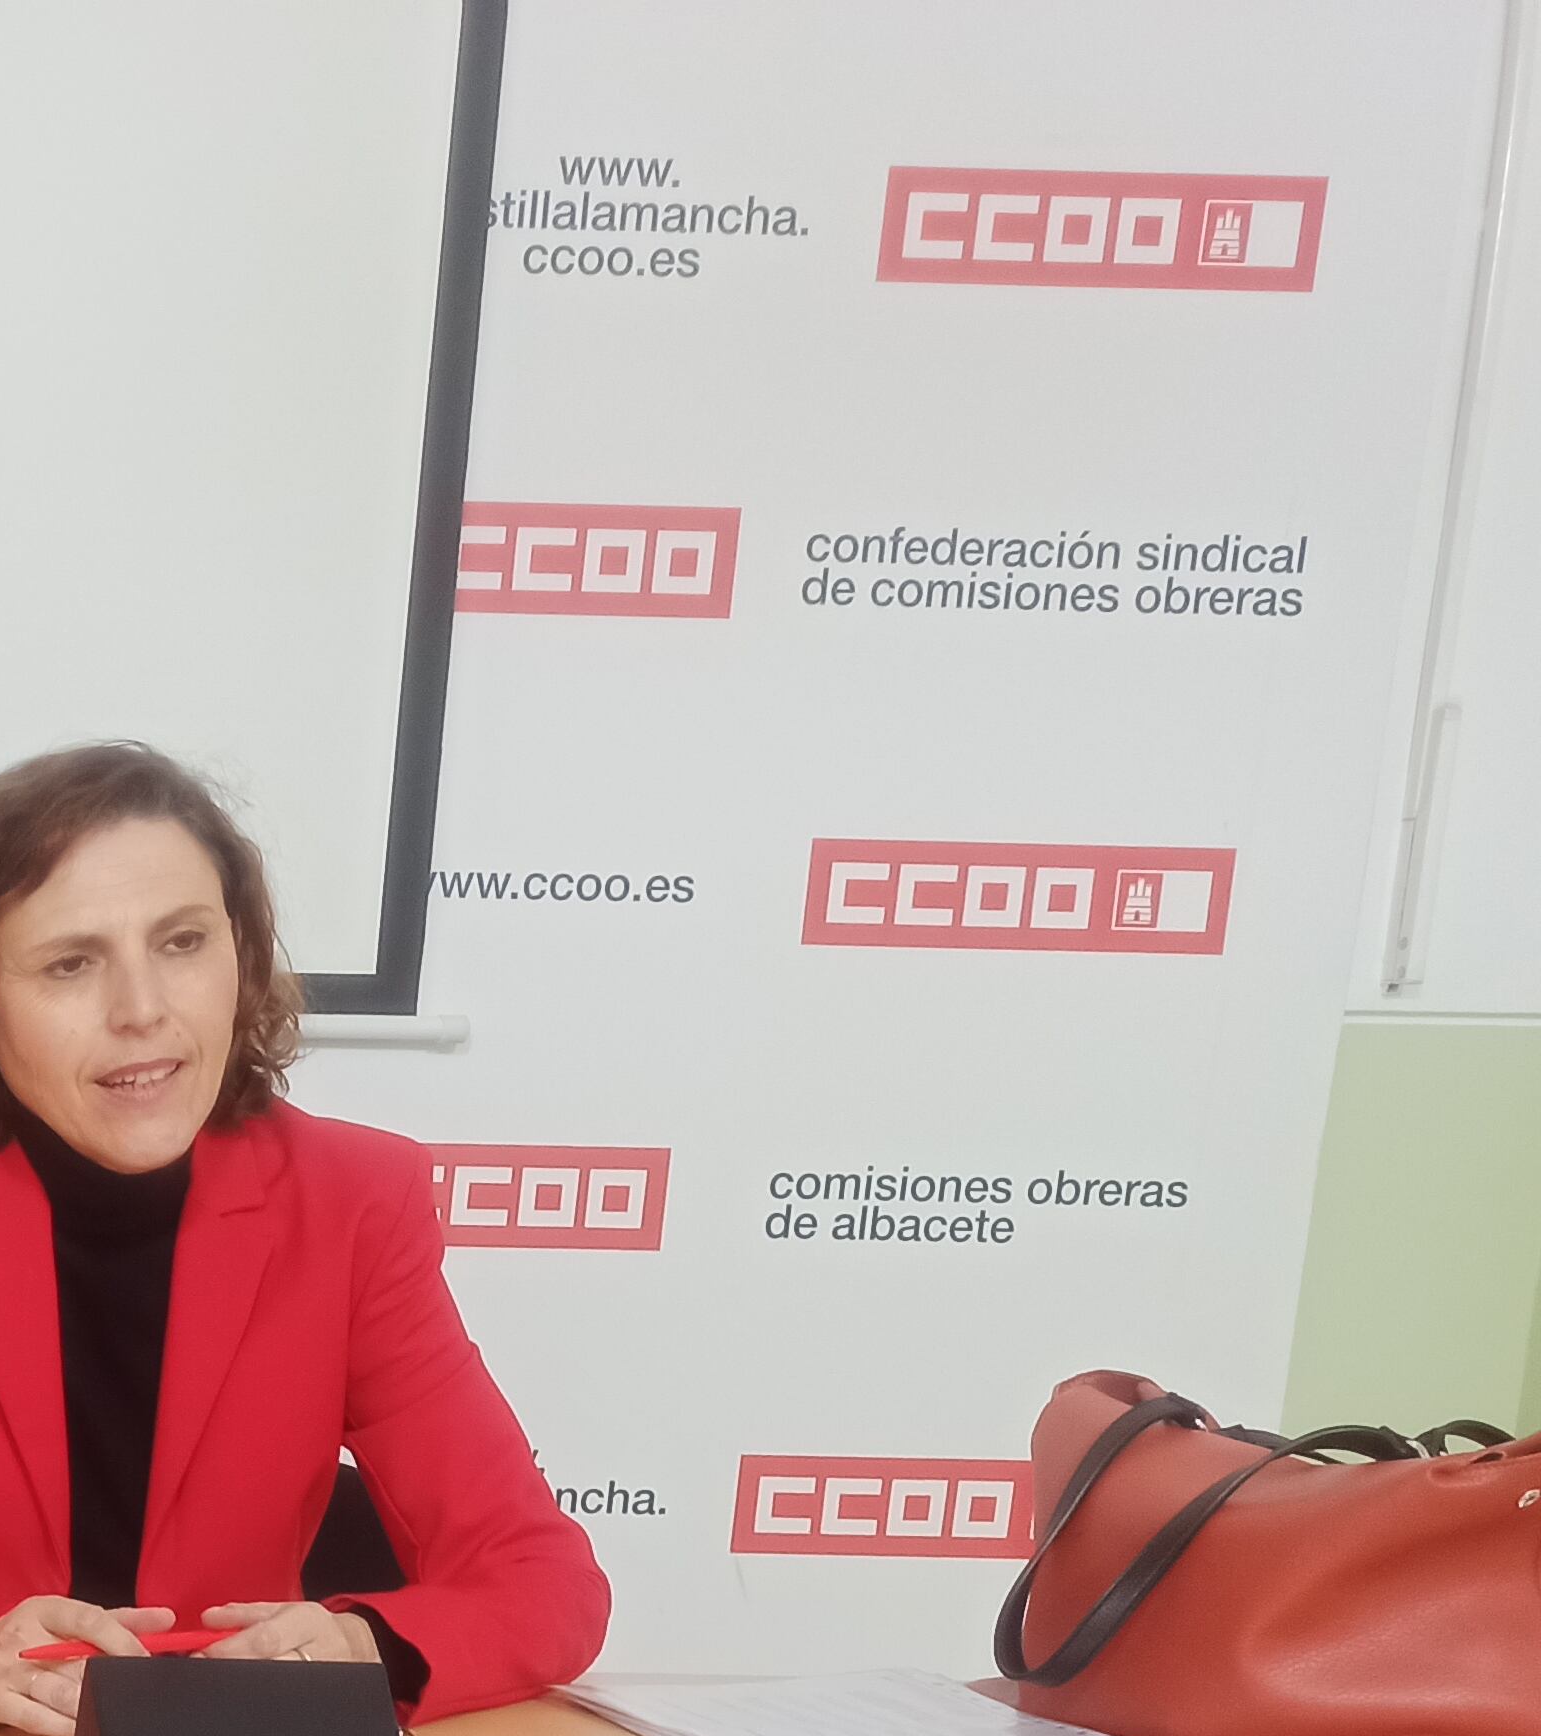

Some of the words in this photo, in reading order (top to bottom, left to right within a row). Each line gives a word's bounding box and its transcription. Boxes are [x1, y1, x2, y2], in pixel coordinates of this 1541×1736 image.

[559, 155, 680, 188] www.
[902, 191, 1183, 265] CCOO
[523, 244, 700, 278] ccoo.es
[456, 525, 718, 595] CCOO
[806, 526, 1121, 573] confederación
[1136, 532, 1308, 574] sindical
[801, 567, 856, 606] de
[870, 570, 1120, 613] comisiones
[1135, 575, 1303, 617] obreras
[825, 861, 1095, 930] CCOO
[432, 1165, 648, 1229] COO
[769, 1164, 1013, 1204] comisiones
[1027, 1169, 1189, 1208] obreras
[765, 1203, 818, 1240] de
[831, 1204, 1015, 1244] albacete
[753, 1475, 1016, 1539] CCOO
